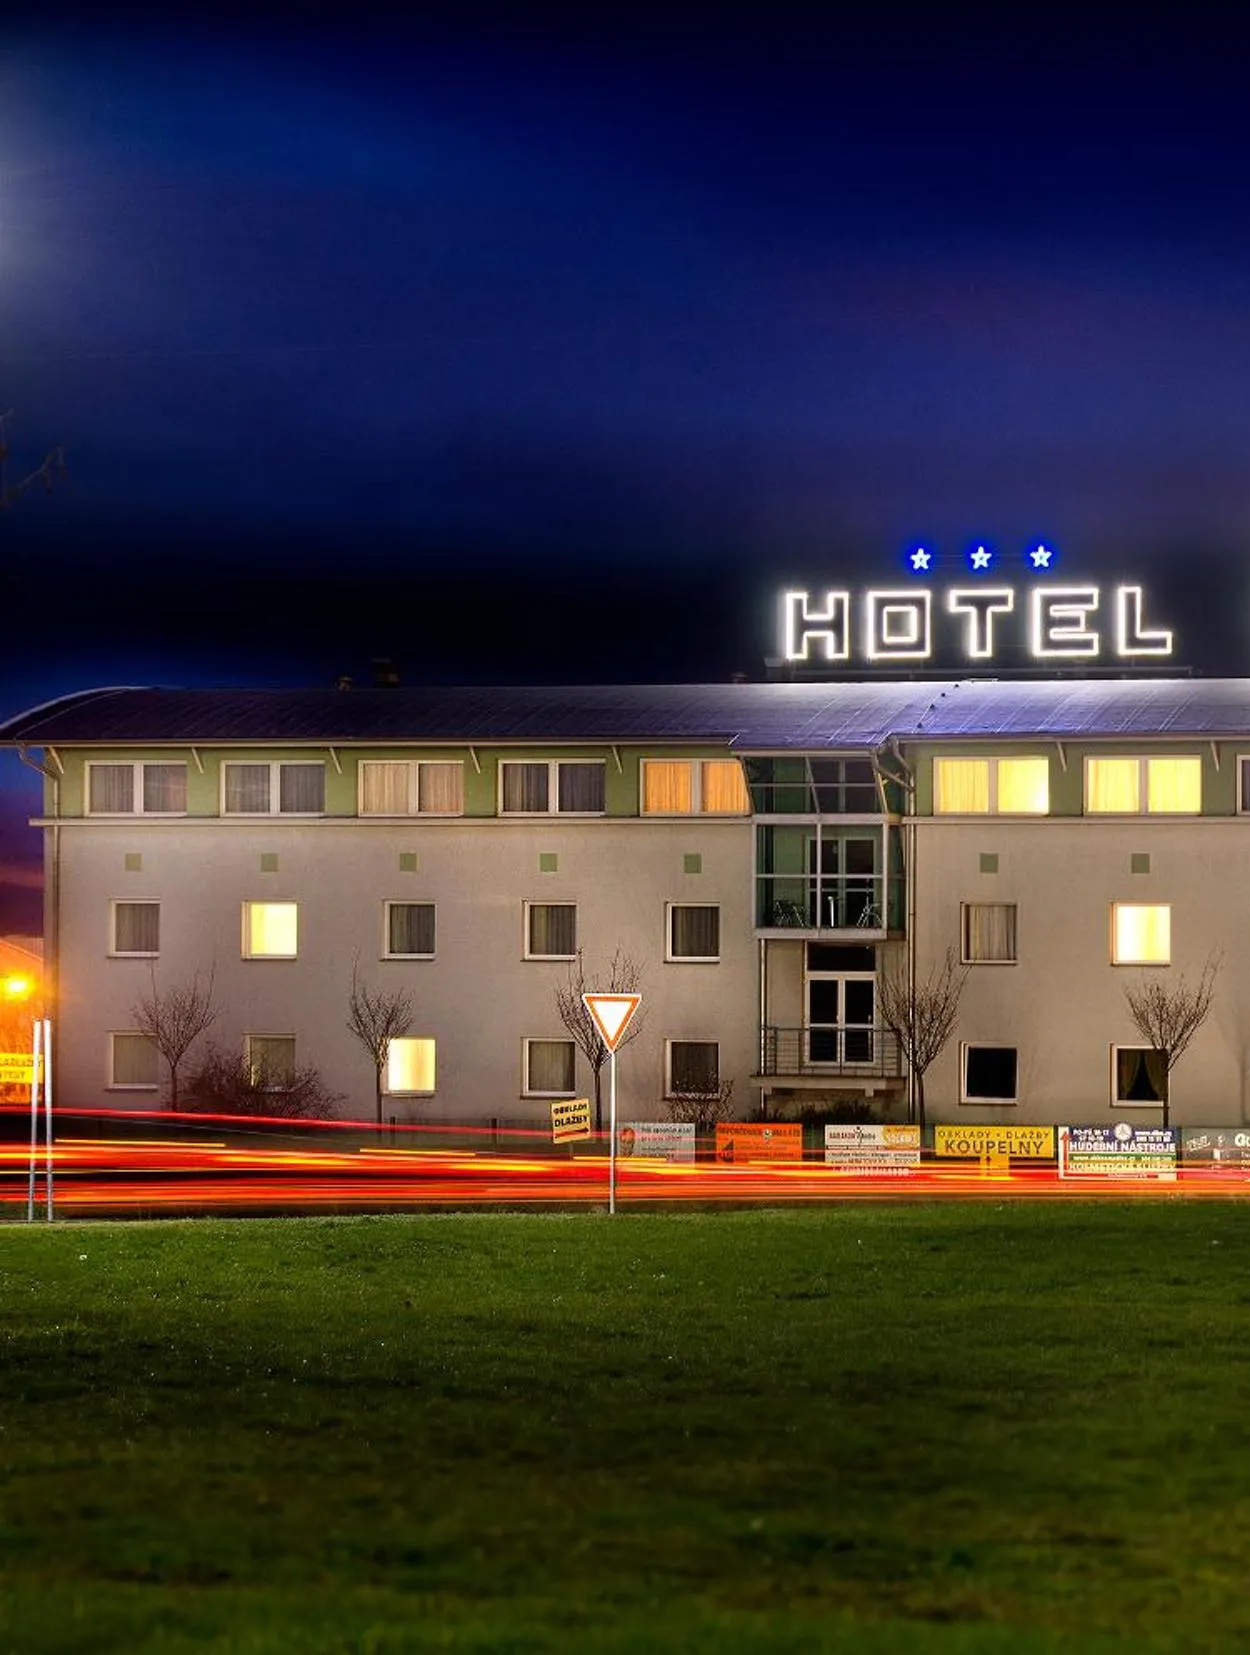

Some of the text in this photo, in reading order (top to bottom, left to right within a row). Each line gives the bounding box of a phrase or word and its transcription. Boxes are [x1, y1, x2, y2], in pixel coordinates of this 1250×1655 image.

[785, 586, 1173, 660] HOTEL
[945, 1140, 1044, 1155] KOUPELNY
[1069, 1140, 1118, 1152] HUDEBNÍ
[1121, 1140, 1176, 1153] NÁSTROJE
